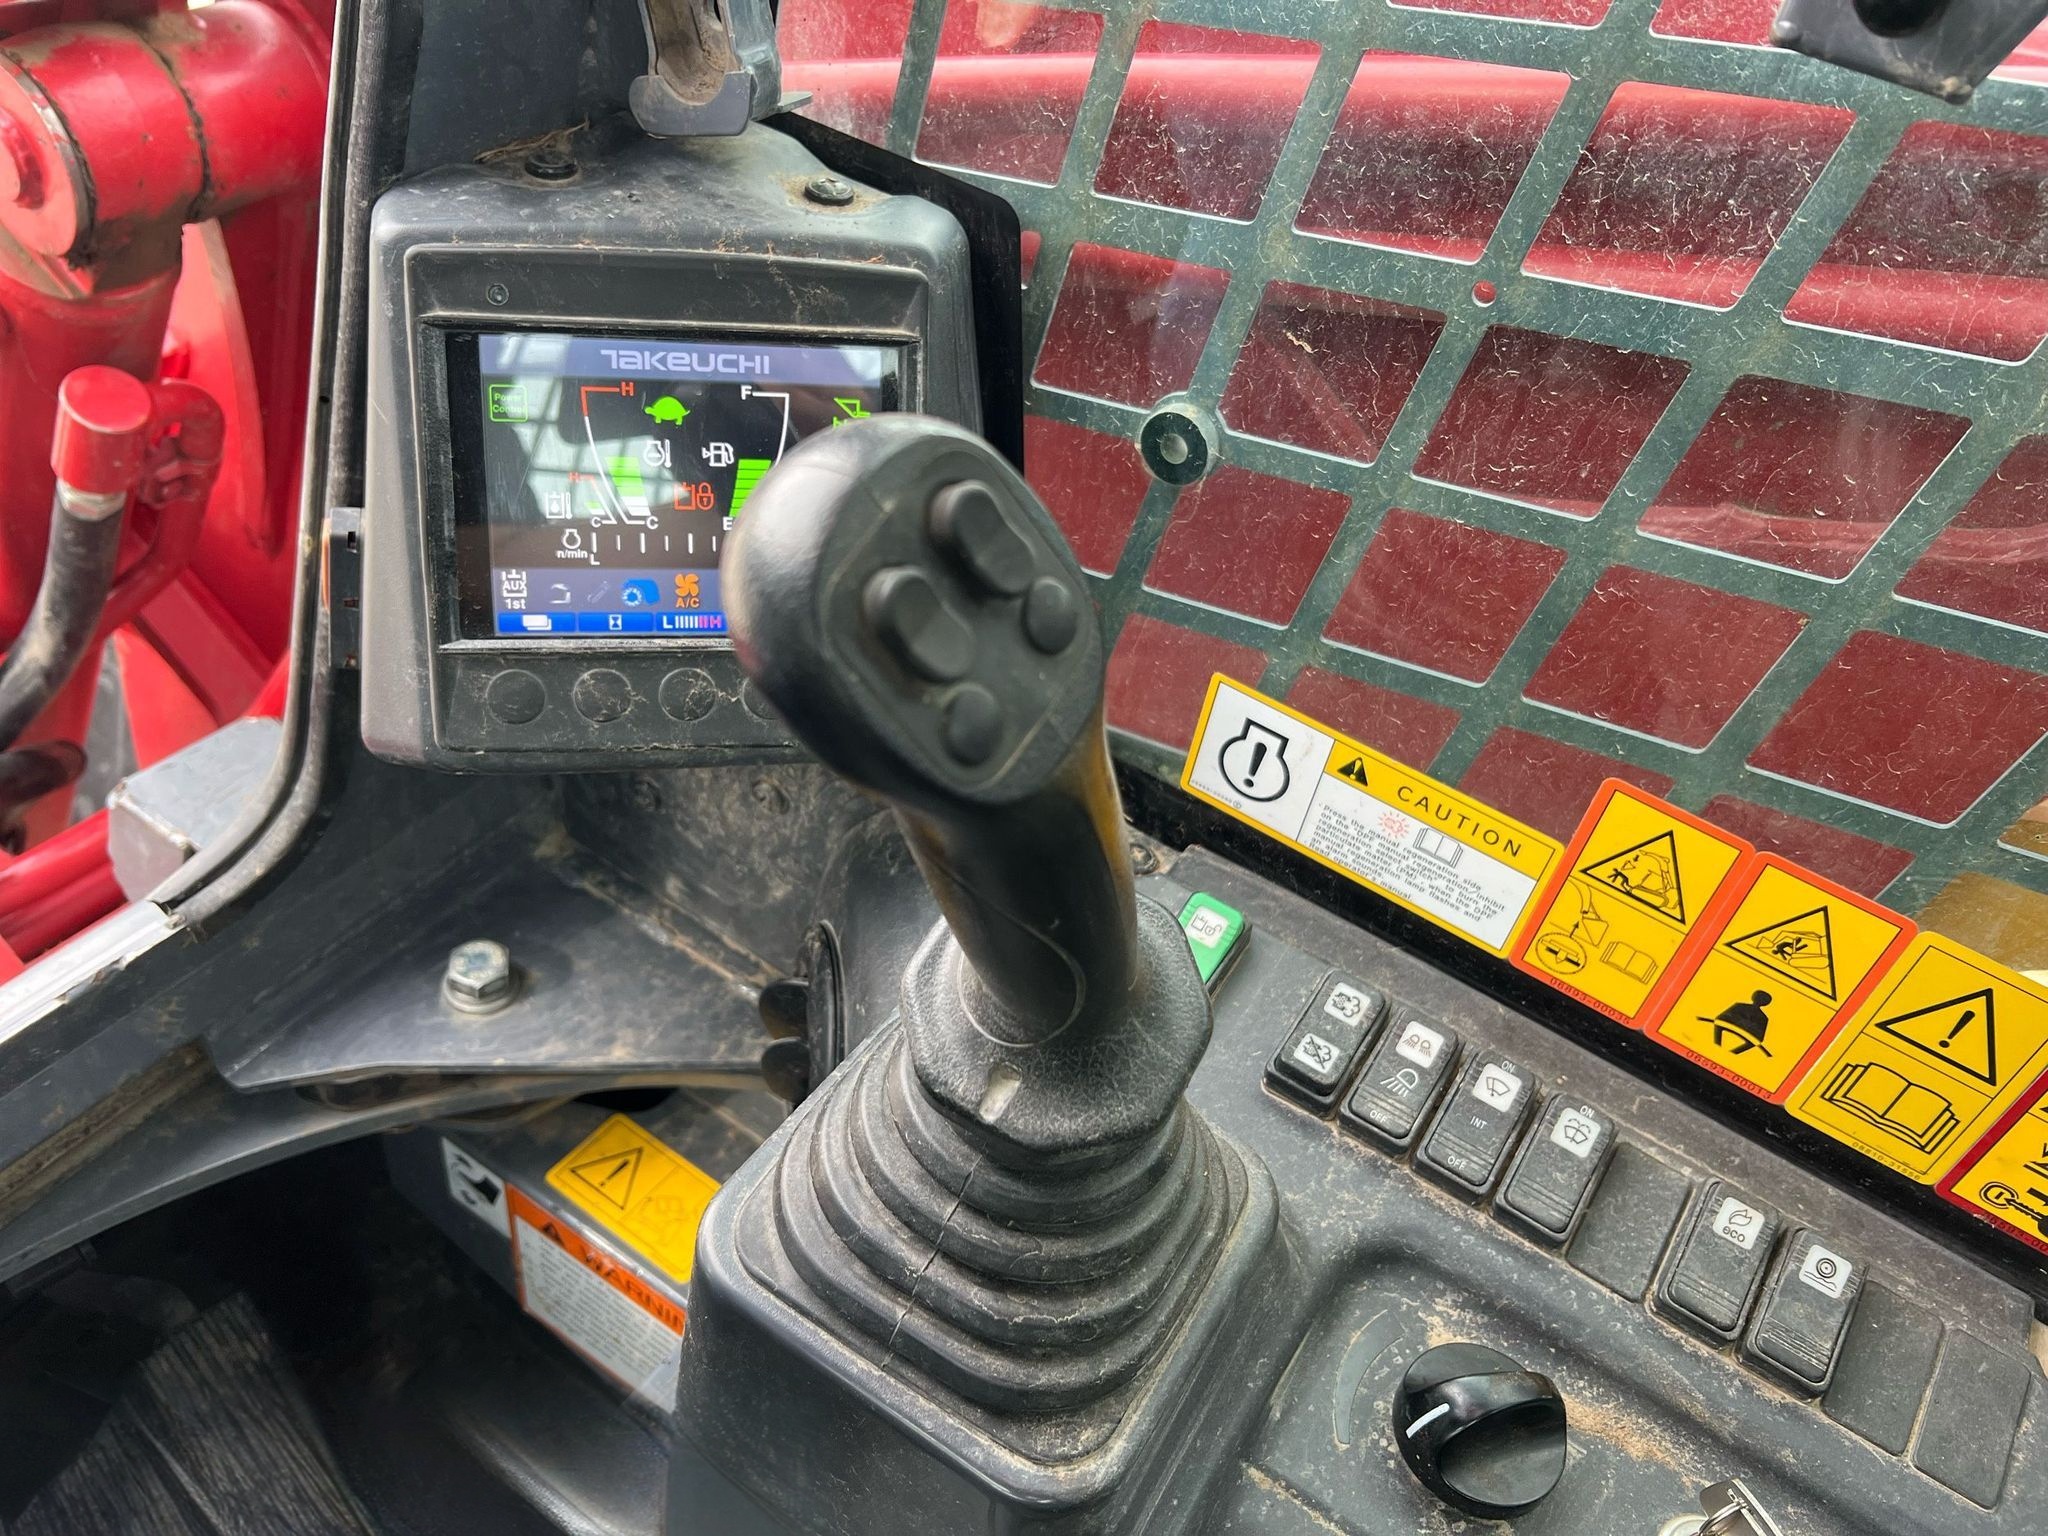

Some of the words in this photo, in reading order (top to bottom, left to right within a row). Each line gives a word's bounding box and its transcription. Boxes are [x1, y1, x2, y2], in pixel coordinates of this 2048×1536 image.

[621, 381, 634, 396] H
[741, 385, 752, 400] F
[591, 516, 602, 528] C
[646, 516, 659, 530] C
[722, 517, 734, 531] E
[556, 549, 588, 559] n/min
[590, 553, 601, 566] L
[503, 580, 527, 590] AUX
[505, 598, 526, 610] 1st
[675, 597, 700, 609] A/C
[1397, 786, 1522, 857] CAUTION
[1320, 811, 1331, 820] on
[1335, 818, 1349, 830] the
[1377, 841, 1409, 861] manual
[1311, 836, 1321, 845] an
[1324, 843, 1348, 859] alarm
[1323, 804, 1347, 821] Press
[1350, 819, 1365, 830] the
[1368, 828, 1399, 848] manual
[1402, 846, 1459, 880] regeneration
[1462, 877, 1482, 891] side
[1315, 823, 1361, 851] particulate
[1364, 849, 1391, 867] matter
[1427, 882, 1451, 898] when
[1455, 897, 1470, 908] the
[1473, 906, 1492, 920] DPF
[1318, 817, 1372, 850] regeneration
[1375, 847, 1401, 864] select
[1445, 883, 1455, 892] to
[1458, 890, 1479, 905] burn
[1482, 903, 1498, 915] the
[1313, 829, 1343, 849] manual
[1346, 847, 1400, 880] regeneration
[1404, 877, 1425, 892] lamp
[1463, 909, 1480, 921] and
[1501, 1060, 1516, 1073] ON
[1369, 1109, 1388, 1124] OFF
[1579, 1105, 1595, 1118] ON
[1470, 1116, 1488, 1130] INT
[1447, 1155, 1467, 1171] OFF
[1722, 1226, 1745, 1242] eco
[580, 1246, 678, 1330] WARNI
